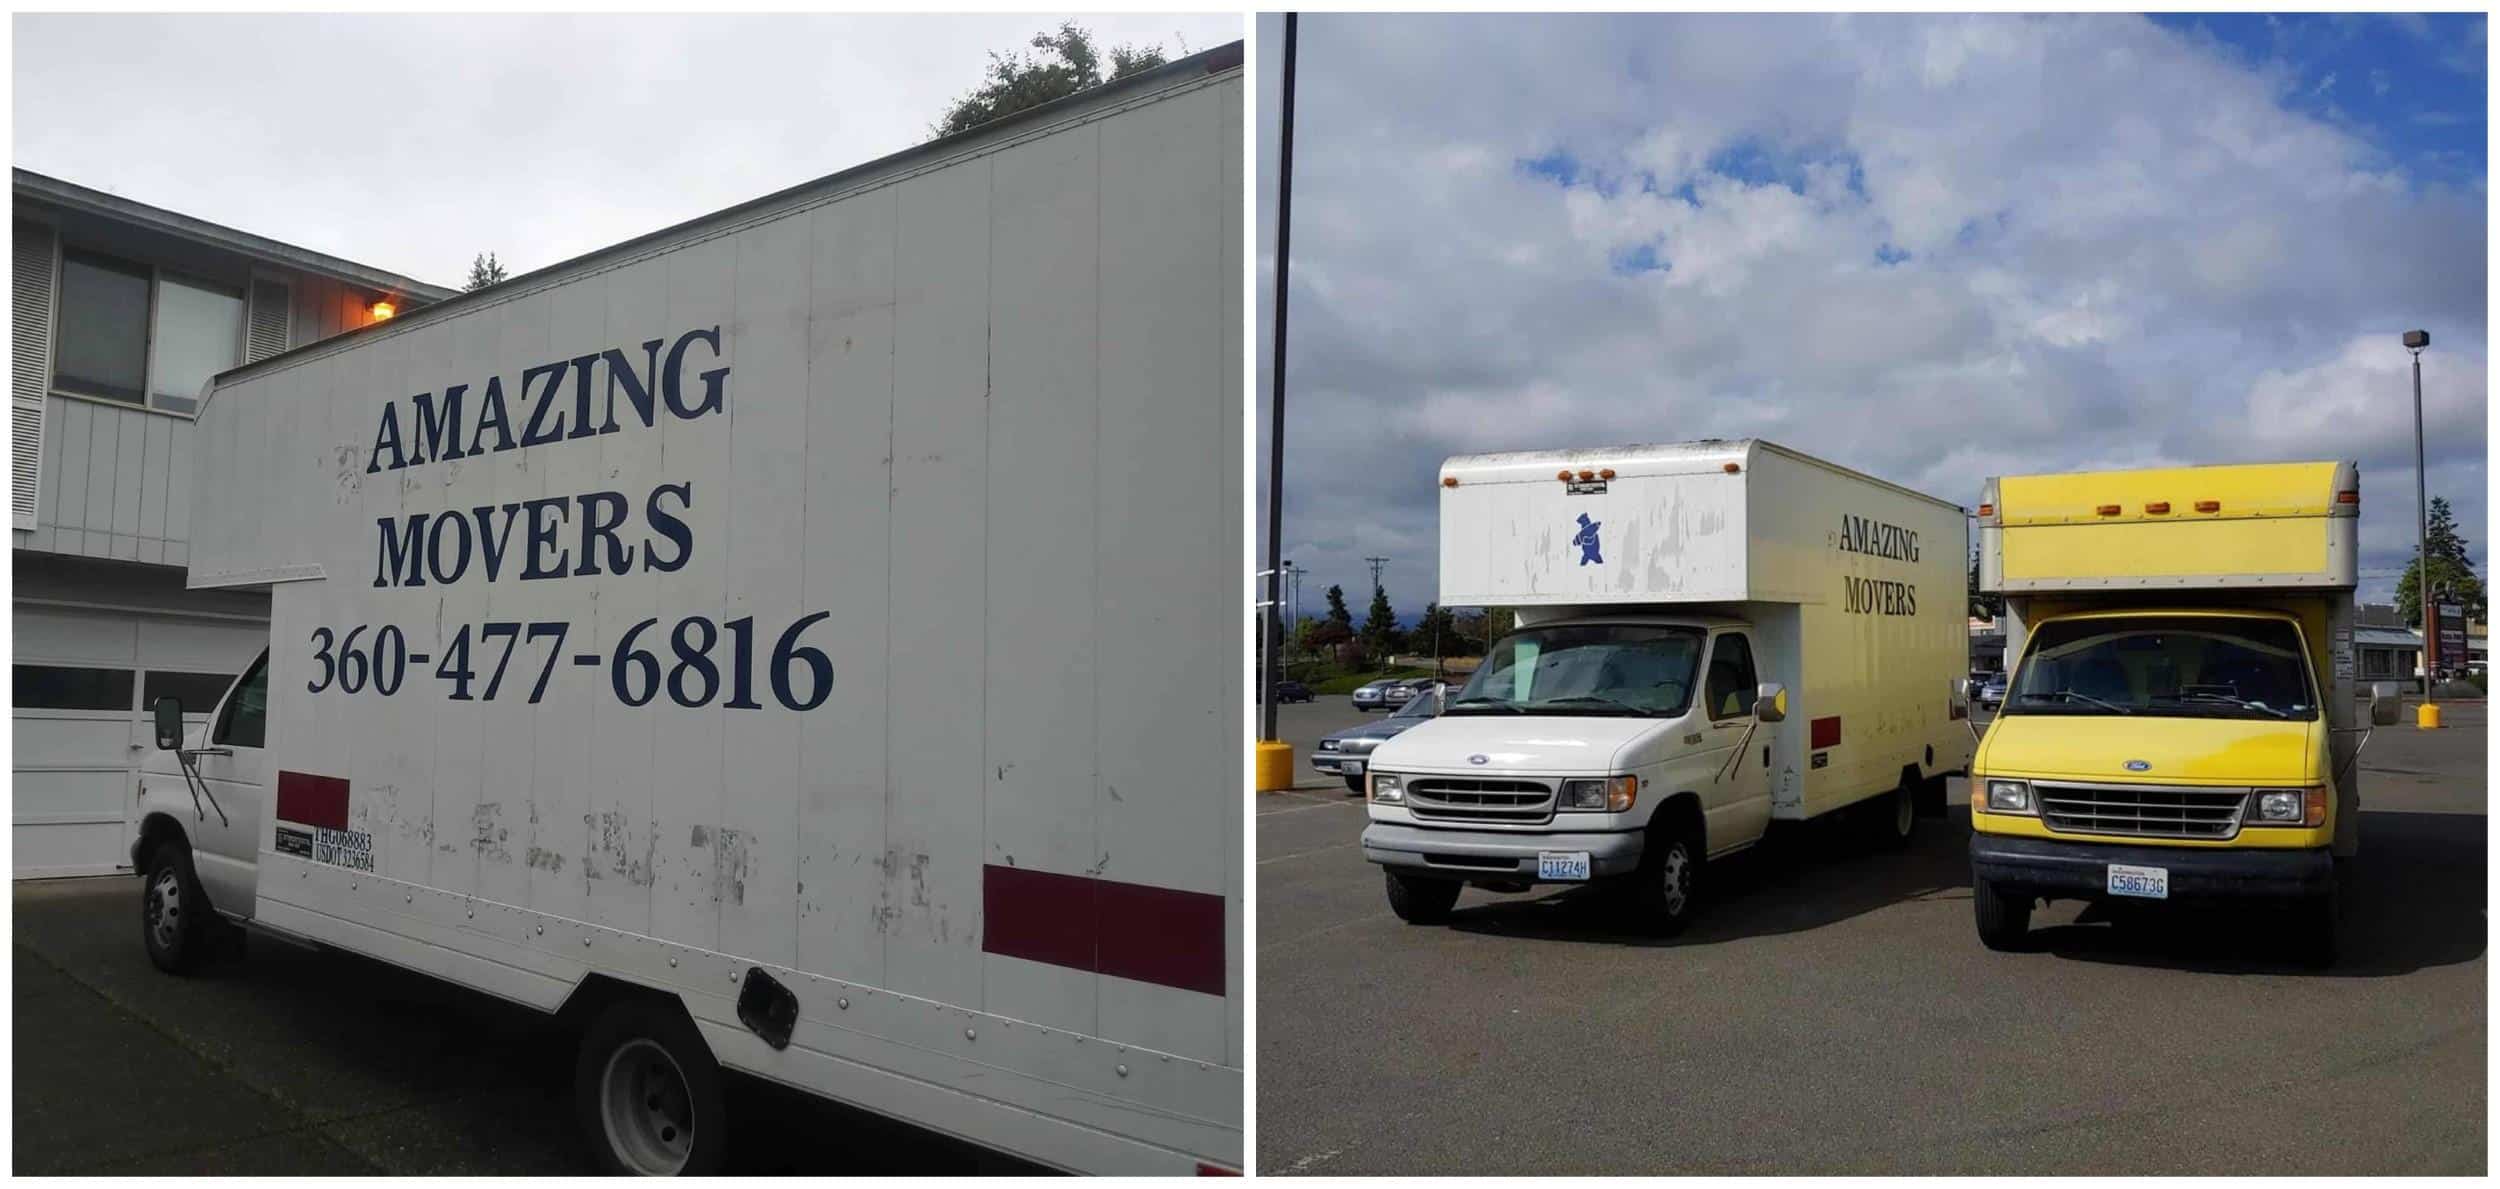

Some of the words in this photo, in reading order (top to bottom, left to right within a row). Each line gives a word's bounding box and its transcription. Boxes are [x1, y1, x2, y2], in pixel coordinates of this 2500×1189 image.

[367, 325, 730, 474] AMAZING
[373, 481, 693, 588] MOVERS
[1840, 513, 1920, 563] AMAZING
[1844, 576, 1916, 616] MOVERS
[307, 611, 834, 711] 360-477-6816
[2111, 874, 2164, 893] C58673G
